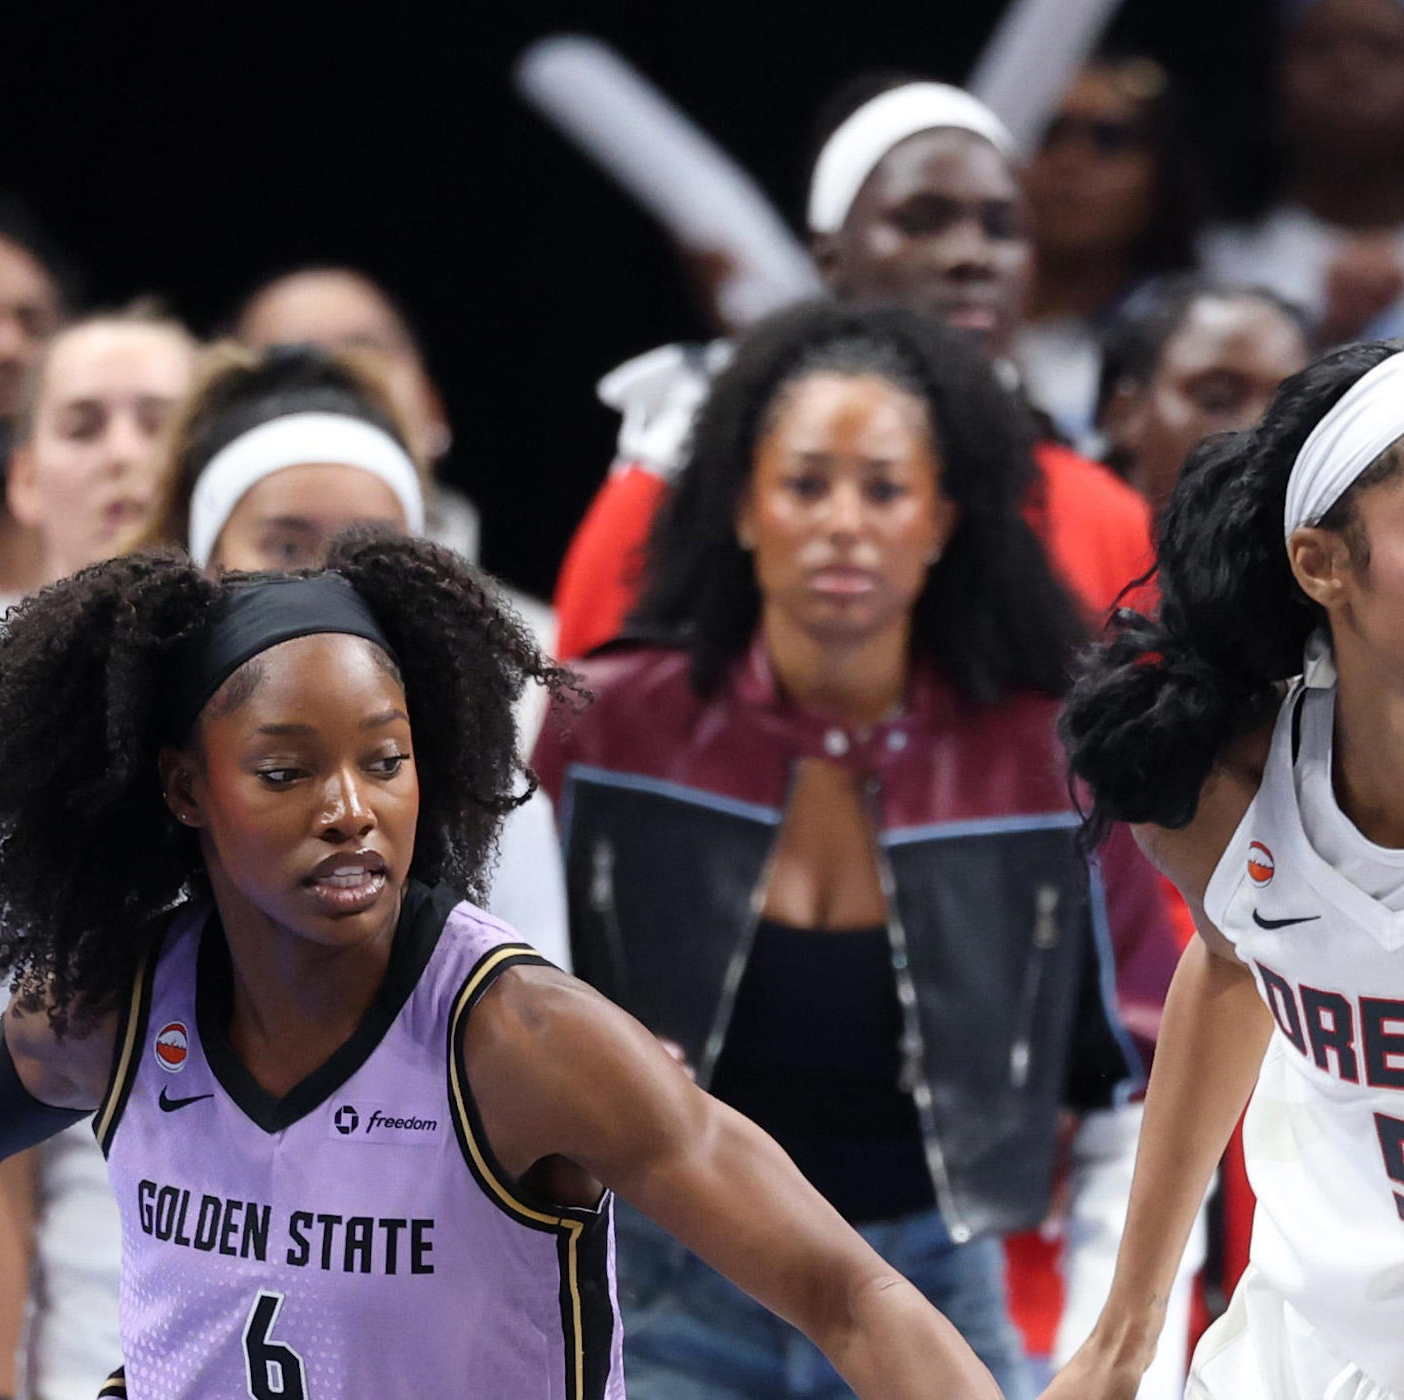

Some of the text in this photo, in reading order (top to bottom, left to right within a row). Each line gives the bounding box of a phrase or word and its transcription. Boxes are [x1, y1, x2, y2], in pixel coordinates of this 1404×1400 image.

[366, 1110, 437, 1134] freedom
[138, 1178, 435, 1276] GOLDEN STATE
